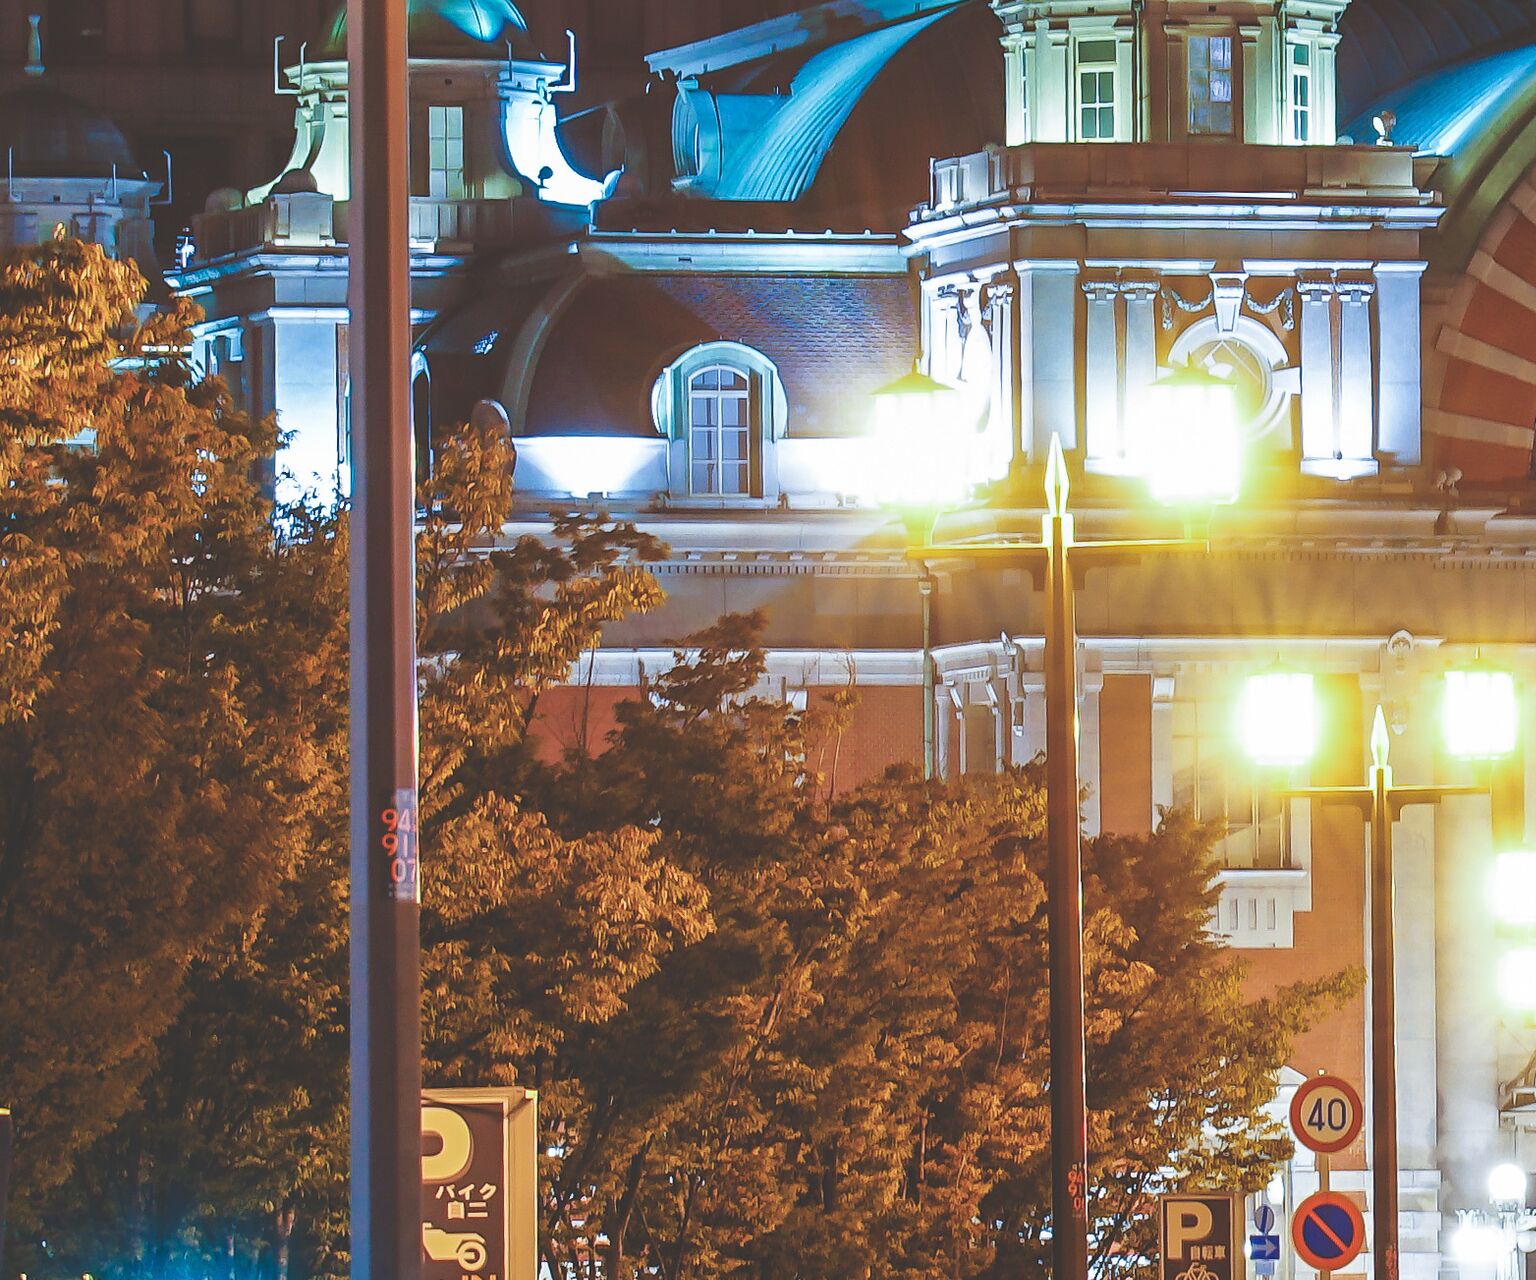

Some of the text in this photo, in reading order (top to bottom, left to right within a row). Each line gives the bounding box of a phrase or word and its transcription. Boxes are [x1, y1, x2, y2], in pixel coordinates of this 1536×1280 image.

[1307, 1096, 1347, 1132] 40
[435, 1183, 497, 1200] バイク
[1167, 1201, 1213, 1260] P
